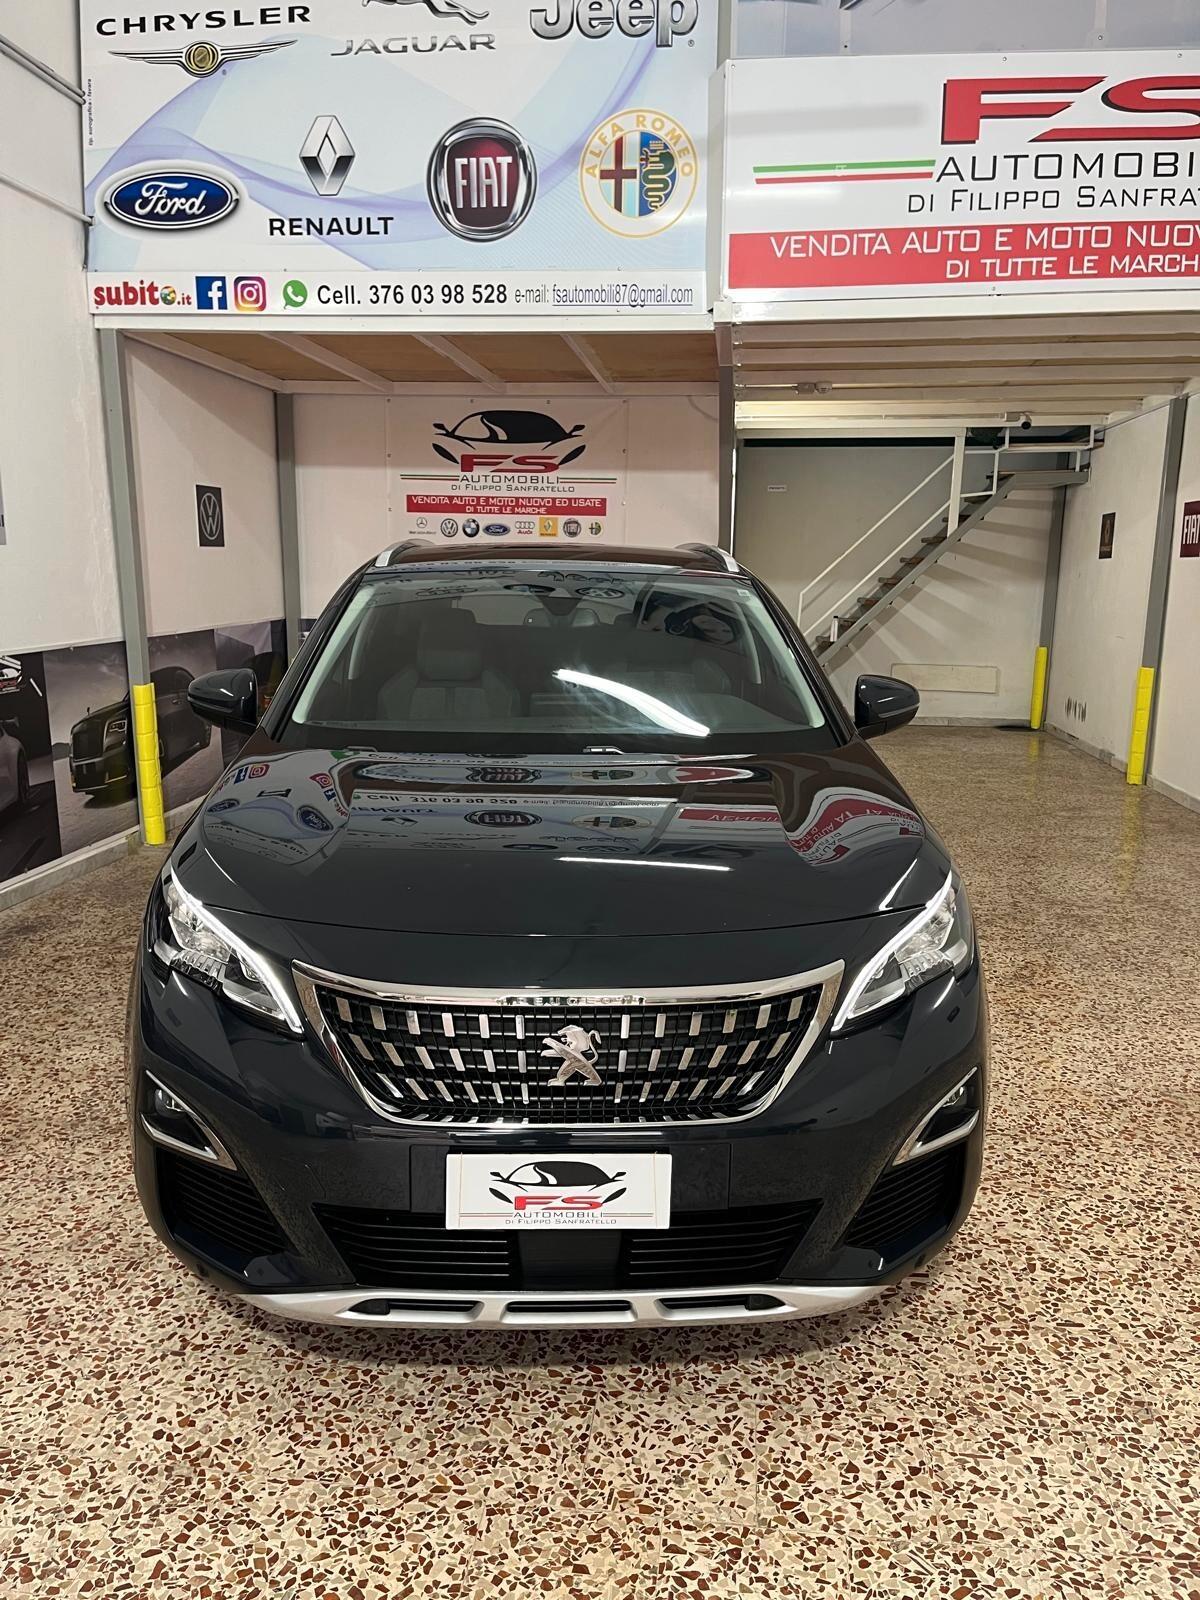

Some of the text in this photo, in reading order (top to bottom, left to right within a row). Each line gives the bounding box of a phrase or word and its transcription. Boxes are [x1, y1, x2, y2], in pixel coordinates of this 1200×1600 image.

[96, 6, 311, 36] CHRYSLER
[530, 0, 699, 48] Jeep
[330, 34, 496, 56] JAGUAR
[941, 75, 1200, 145] FS
[585, 114, 694, 178] ALFA ROMEO
[936, 151, 1194, 183] AUTOMOBI
[455, 156, 512, 208] FIAT
[134, 182, 206, 216] Ford
[908, 193, 934, 214] DI
[1077, 185, 1200, 208] SANFRA
[269, 217, 393, 236] RENAULT
[770, 232, 891, 259] VENDITA
[902, 229, 981, 255] AUTO
[995, 228, 1013, 251] E
[1026, 225, 1112, 250] MOTO
[946, 254, 1199, 279] DI TUTTE LE MARCH
[317, 283, 693, 307] Cell. 376 03 98 528 e-mail: fsautomobili87@gmail.com
[461, 454, 560, 474] FS
[460, 474, 559, 485] AUTOMOBILI
[412, 495, 601, 508] VENDITA AUTO E MOTO NUOVO ED USATE
[1182, 514, 1200, 545] FIAT
[513, 1211, 603, 1219] AUTOMOBILI
[514, 1195, 603, 1211] FS
